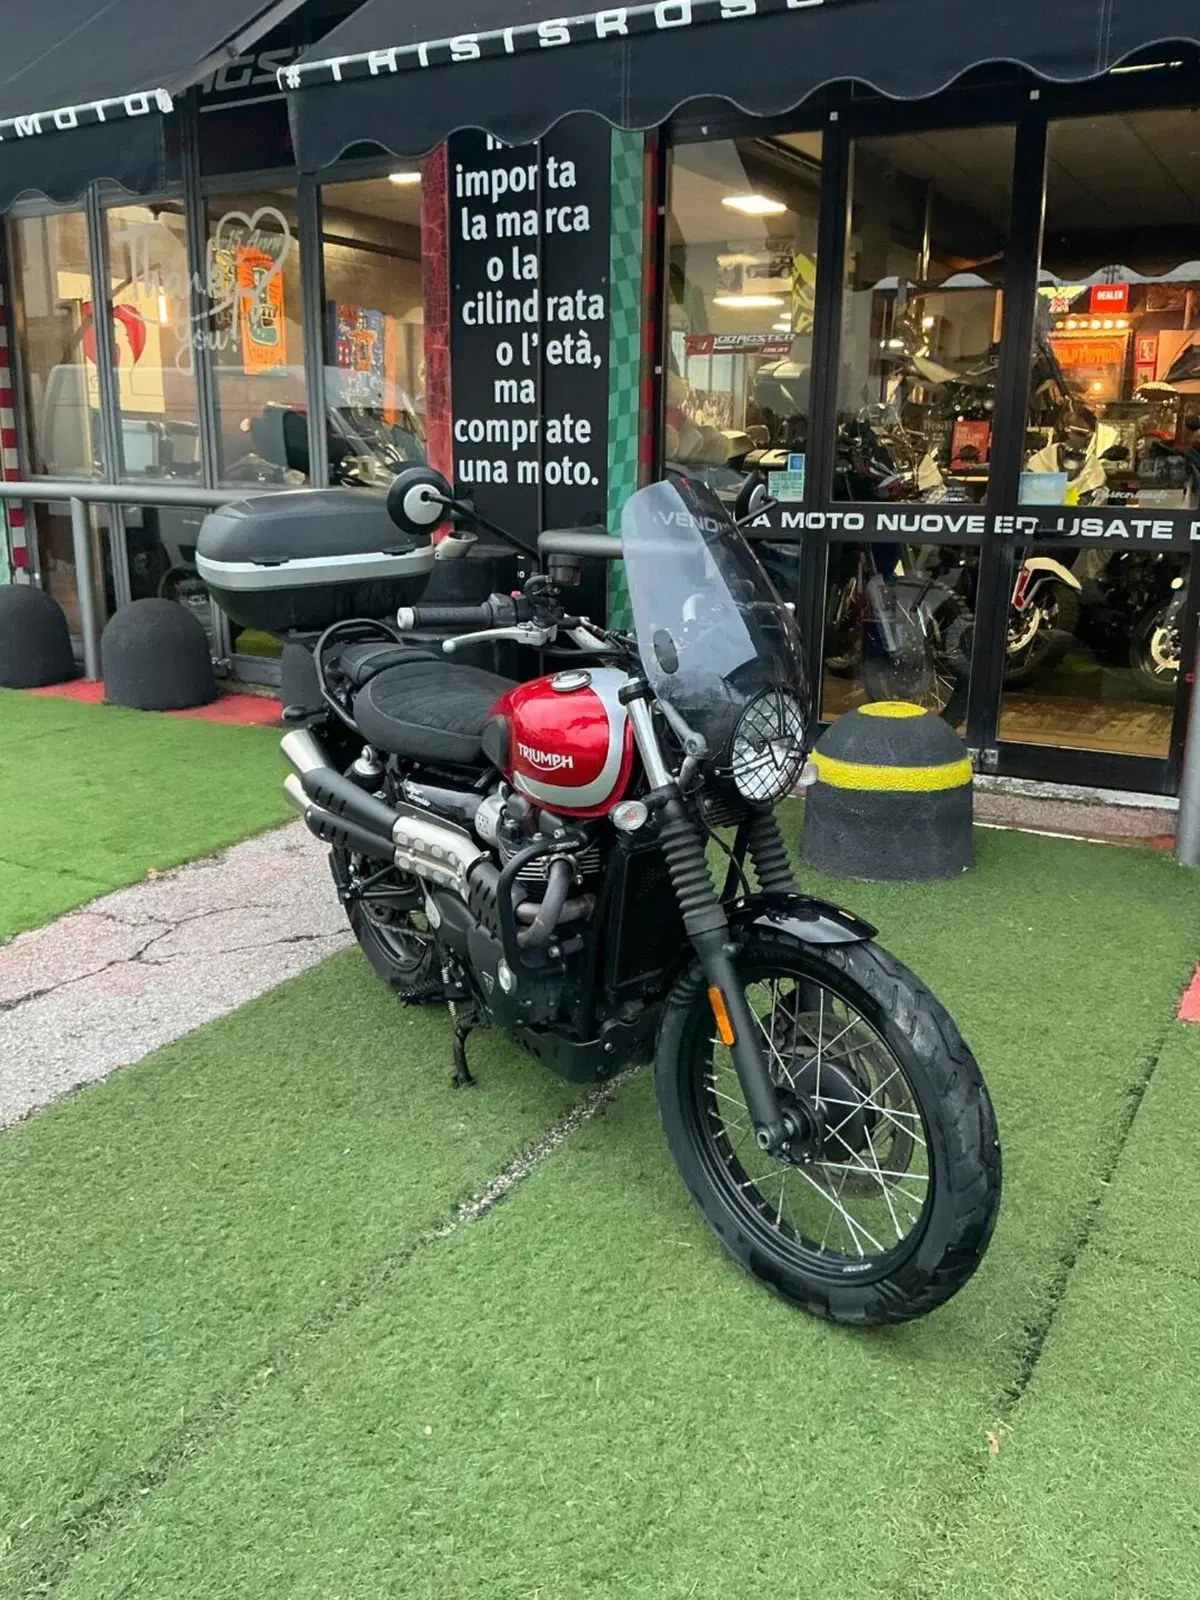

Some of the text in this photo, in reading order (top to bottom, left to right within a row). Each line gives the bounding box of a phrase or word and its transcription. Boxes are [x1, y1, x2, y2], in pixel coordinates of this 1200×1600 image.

[456, 156, 576, 204] importa
[461, 204, 590, 241] la marca
[487, 246, 538, 281] o la
[462, 288, 605, 325] cilindrata
[1096, 290, 1124, 301] DEALER
[496, 342, 513, 366] o
[494, 379, 535, 404] ma
[454, 413, 591, 451] comprate
[459, 455, 599, 486] una moto.
[781, 512, 864, 530] MOTO
[876, 513, 986, 533] NUOVE
[1057, 517, 1174, 540] USATE
[518, 742, 574, 770] TRIUMPH
